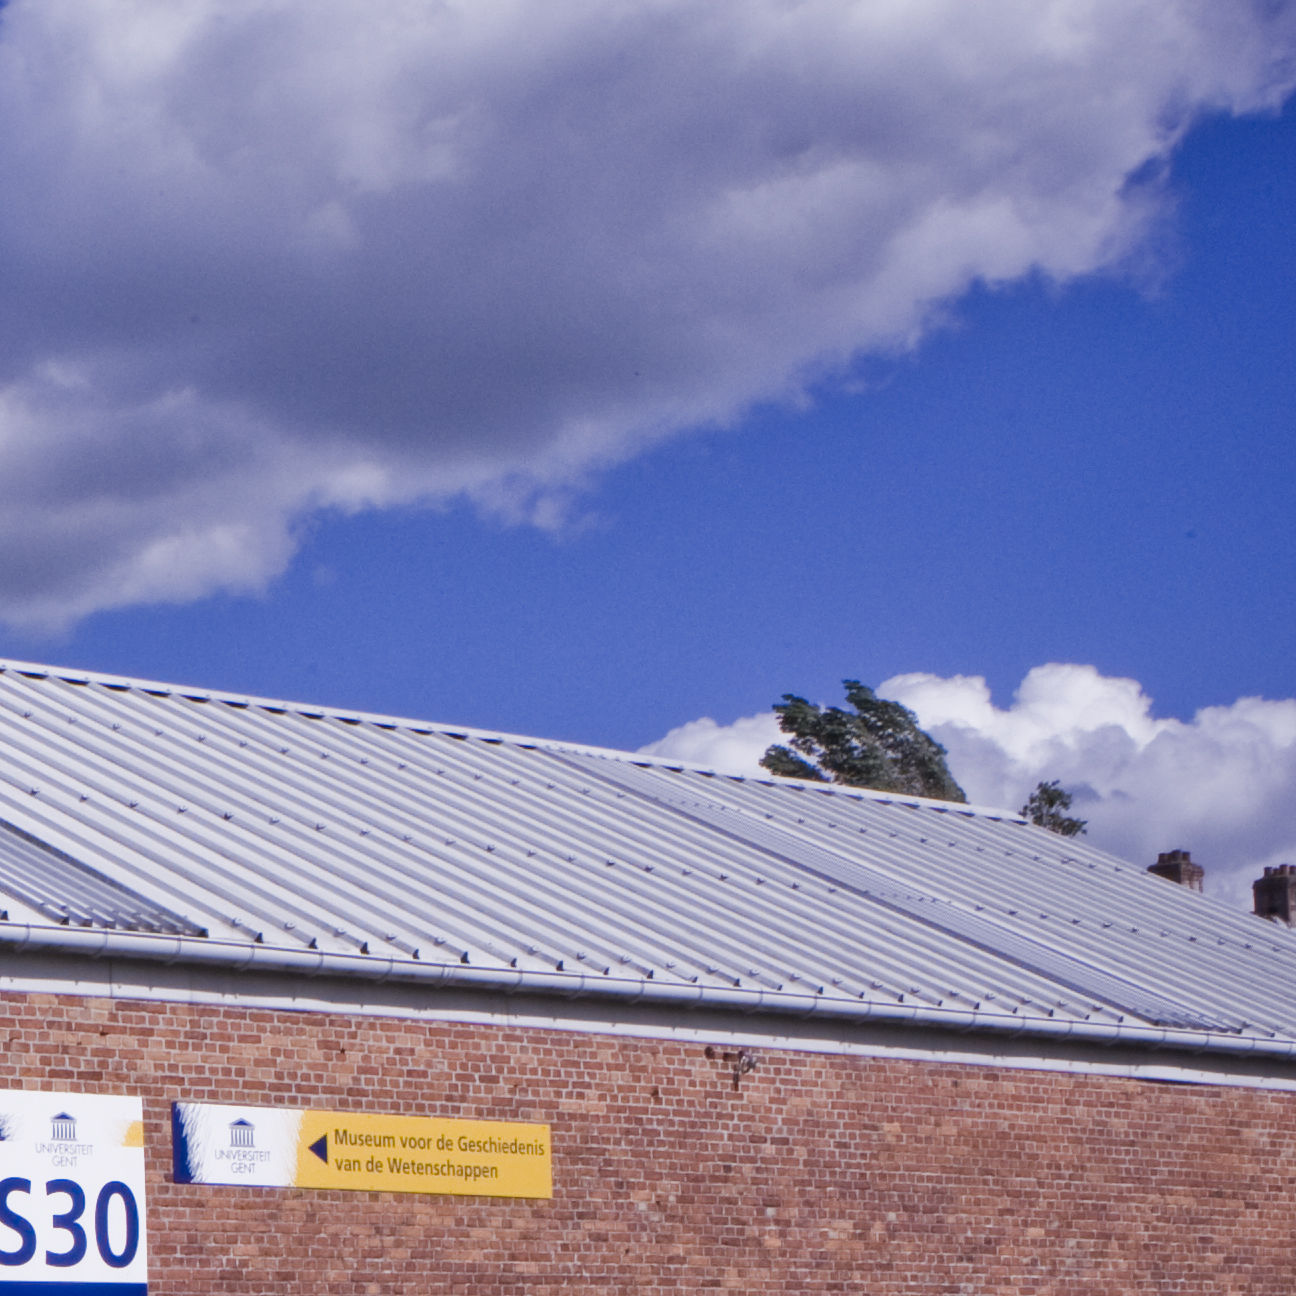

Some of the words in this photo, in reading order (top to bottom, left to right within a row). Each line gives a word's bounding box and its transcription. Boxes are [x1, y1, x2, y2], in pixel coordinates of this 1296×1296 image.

[334, 1128, 396, 1147] Museum
[399, 1136, 431, 1150] voor
[436, 1133, 453, 1151] de
[457, 1135, 545, 1156] Geschiedenis
[35, 1143, 93, 1156] UNIVERSITEIT
[214, 1149, 271, 1162] UNIVERSITEIT
[51, 1155, 77, 1168] GENT
[230, 1162, 256, 1174] GENT
[334, 1157, 361, 1172] van
[365, 1155, 383, 1173] de
[387, 1157, 499, 1182] Wetenschappen
